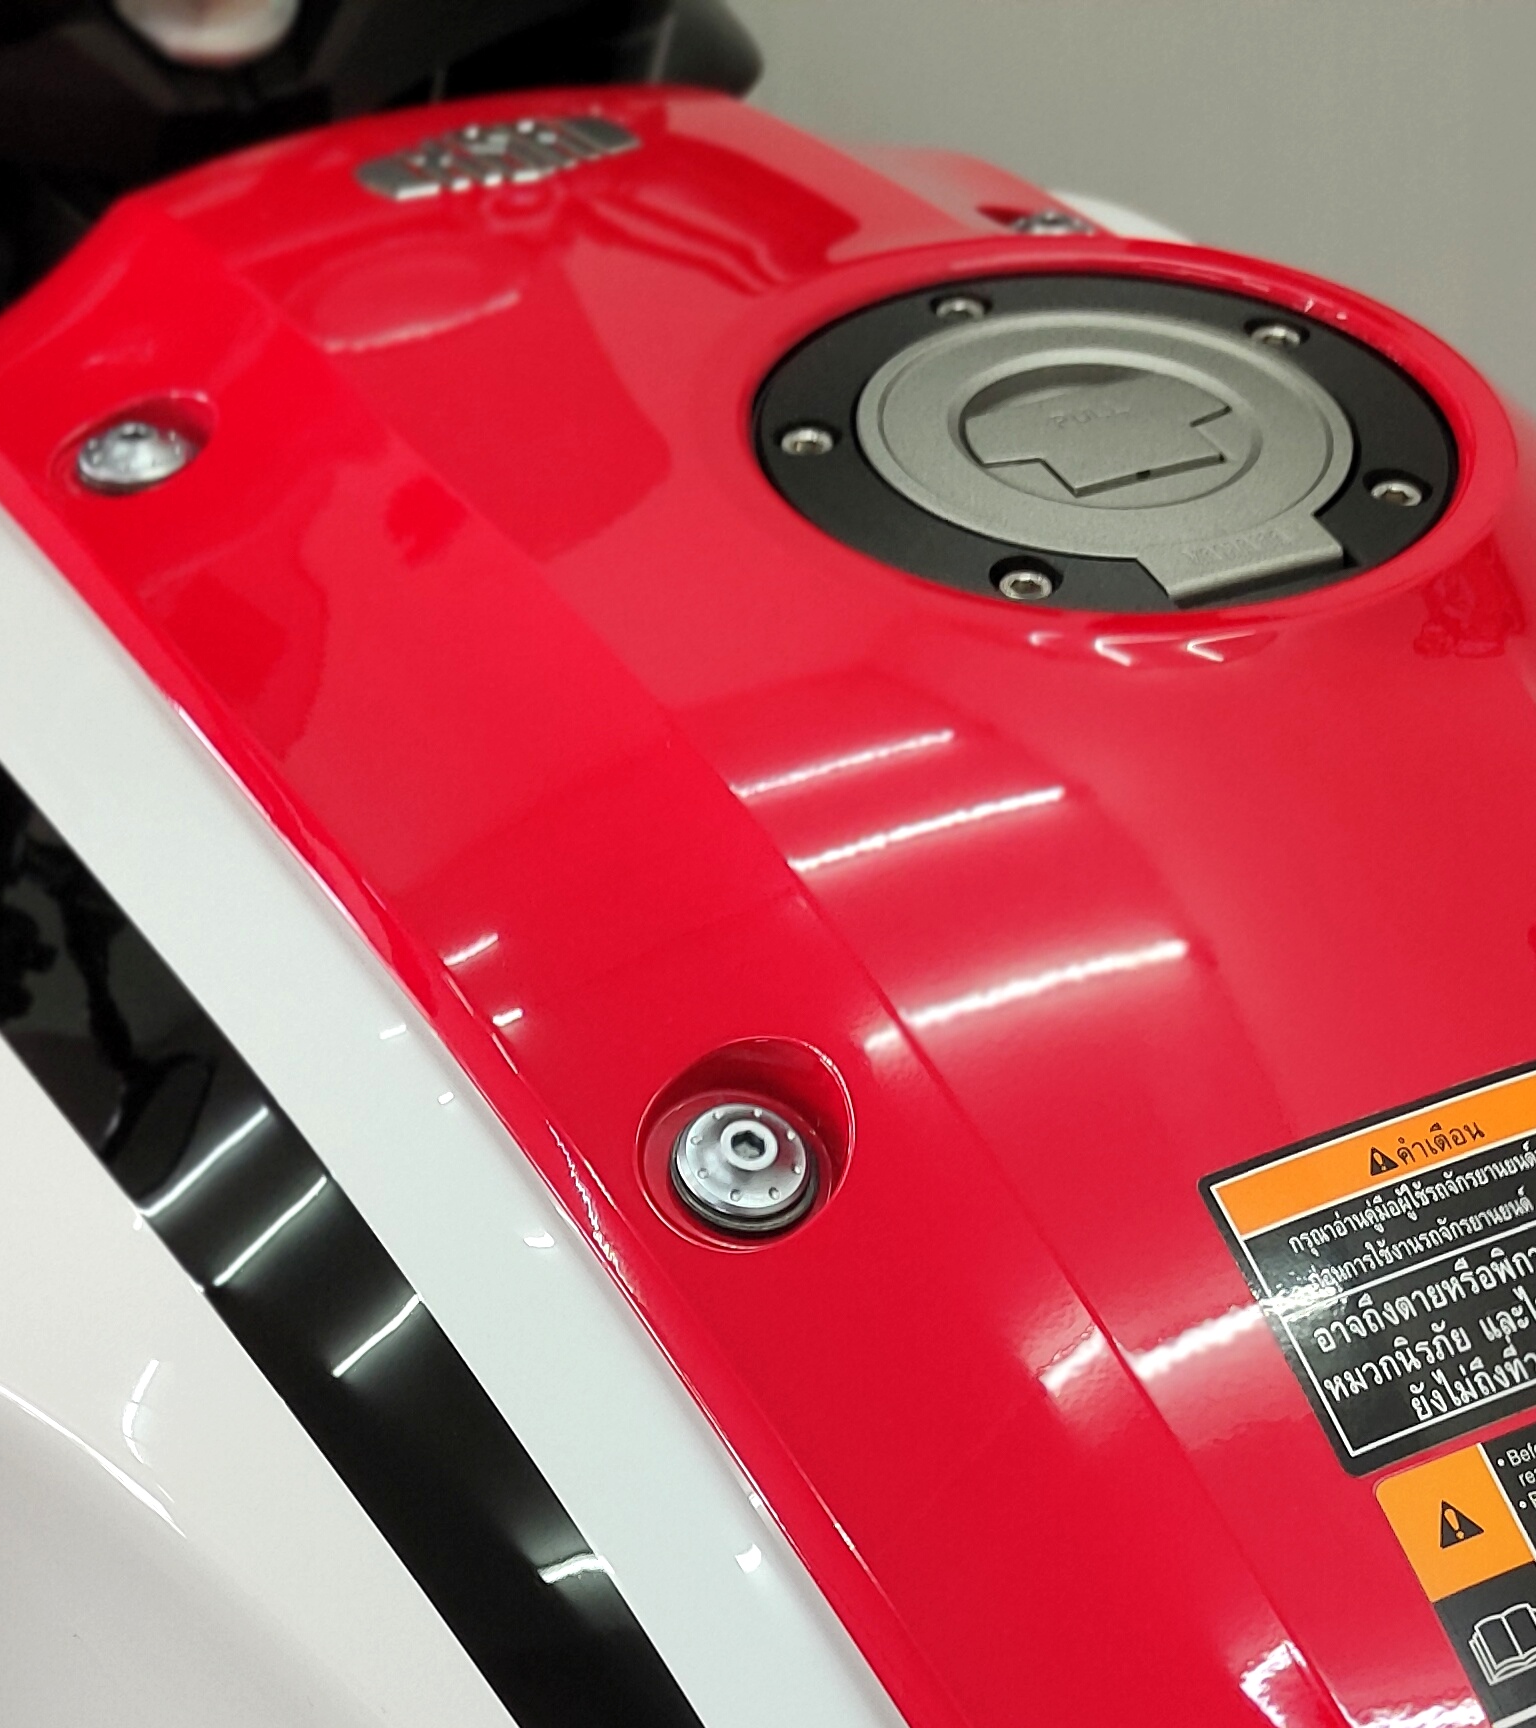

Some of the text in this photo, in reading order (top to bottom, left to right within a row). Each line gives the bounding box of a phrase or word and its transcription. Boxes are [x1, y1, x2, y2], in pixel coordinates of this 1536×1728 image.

[1395, 1121, 1485, 1166] คำเตือน
[1322, 1318, 1472, 1402] หมวกนิรภัย
